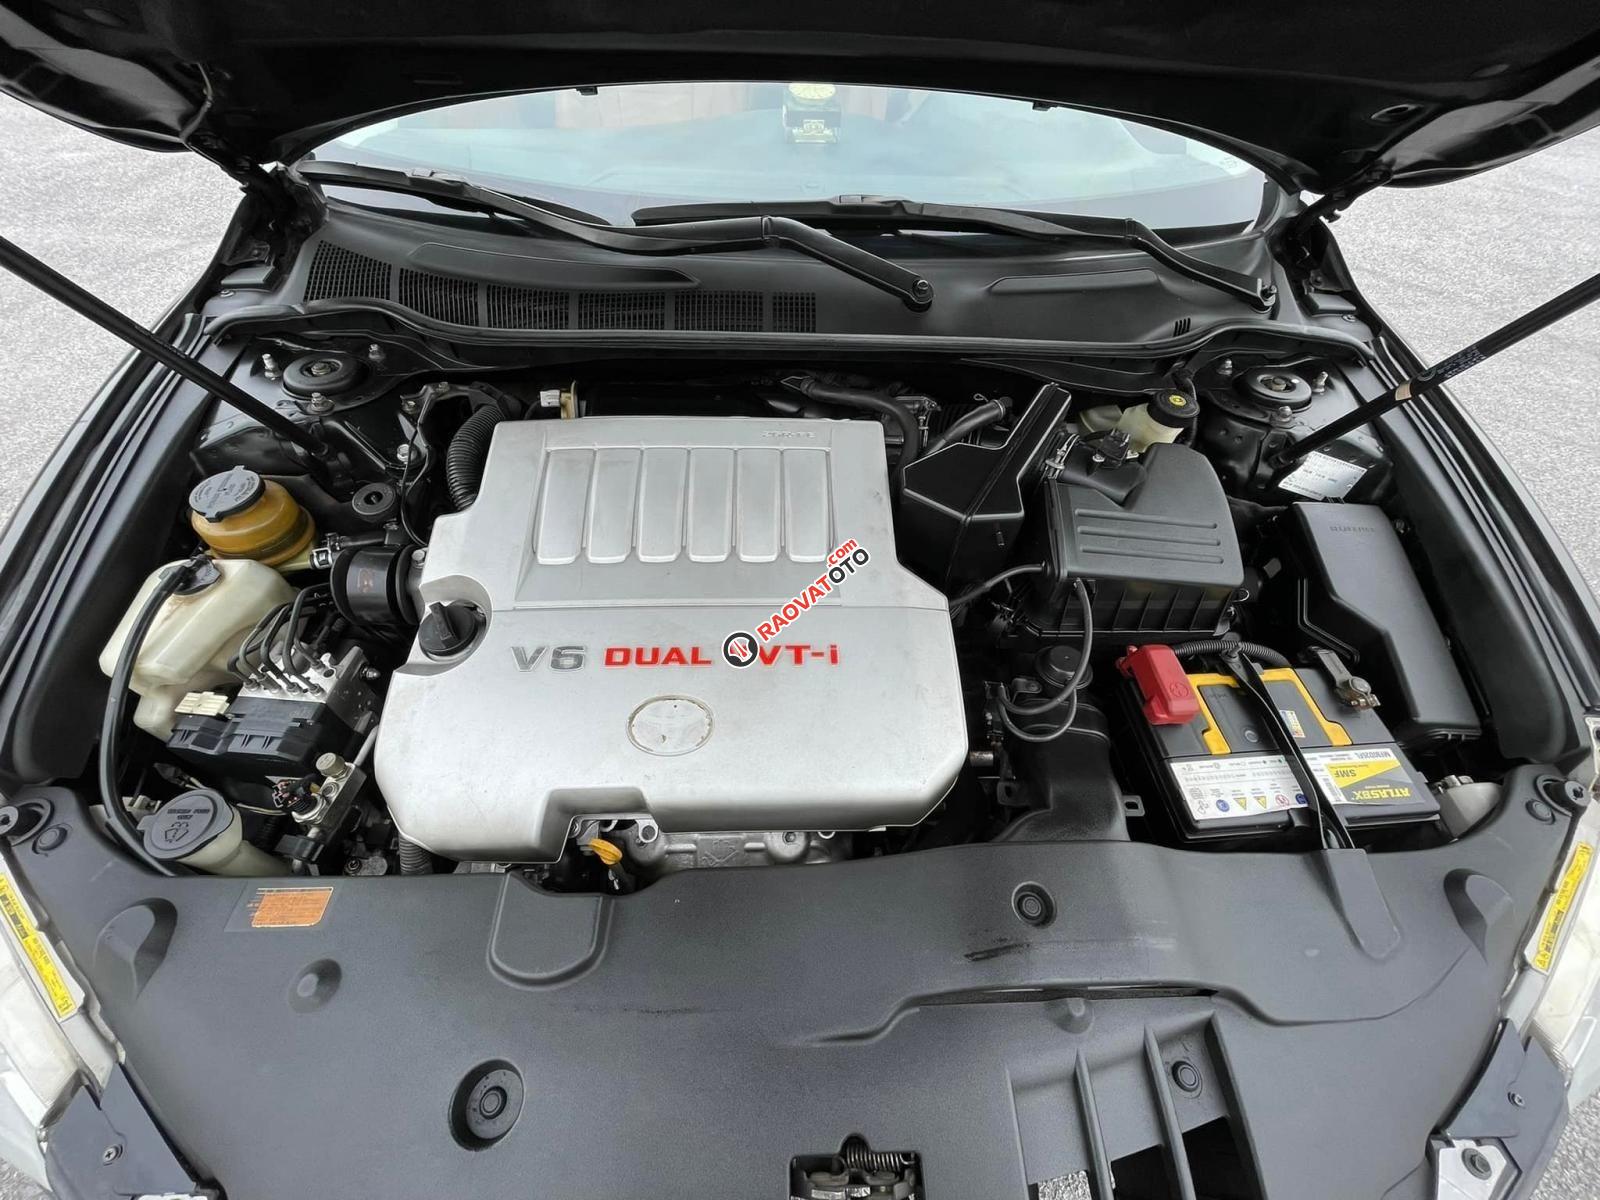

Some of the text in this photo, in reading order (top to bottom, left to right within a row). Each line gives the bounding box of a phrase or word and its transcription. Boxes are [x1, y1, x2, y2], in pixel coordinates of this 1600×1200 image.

[511, 644, 839, 671] V6 DUAL VT-i
[1334, 768, 1357, 778] SMF
[1354, 787, 1410, 801] ATLASBX
